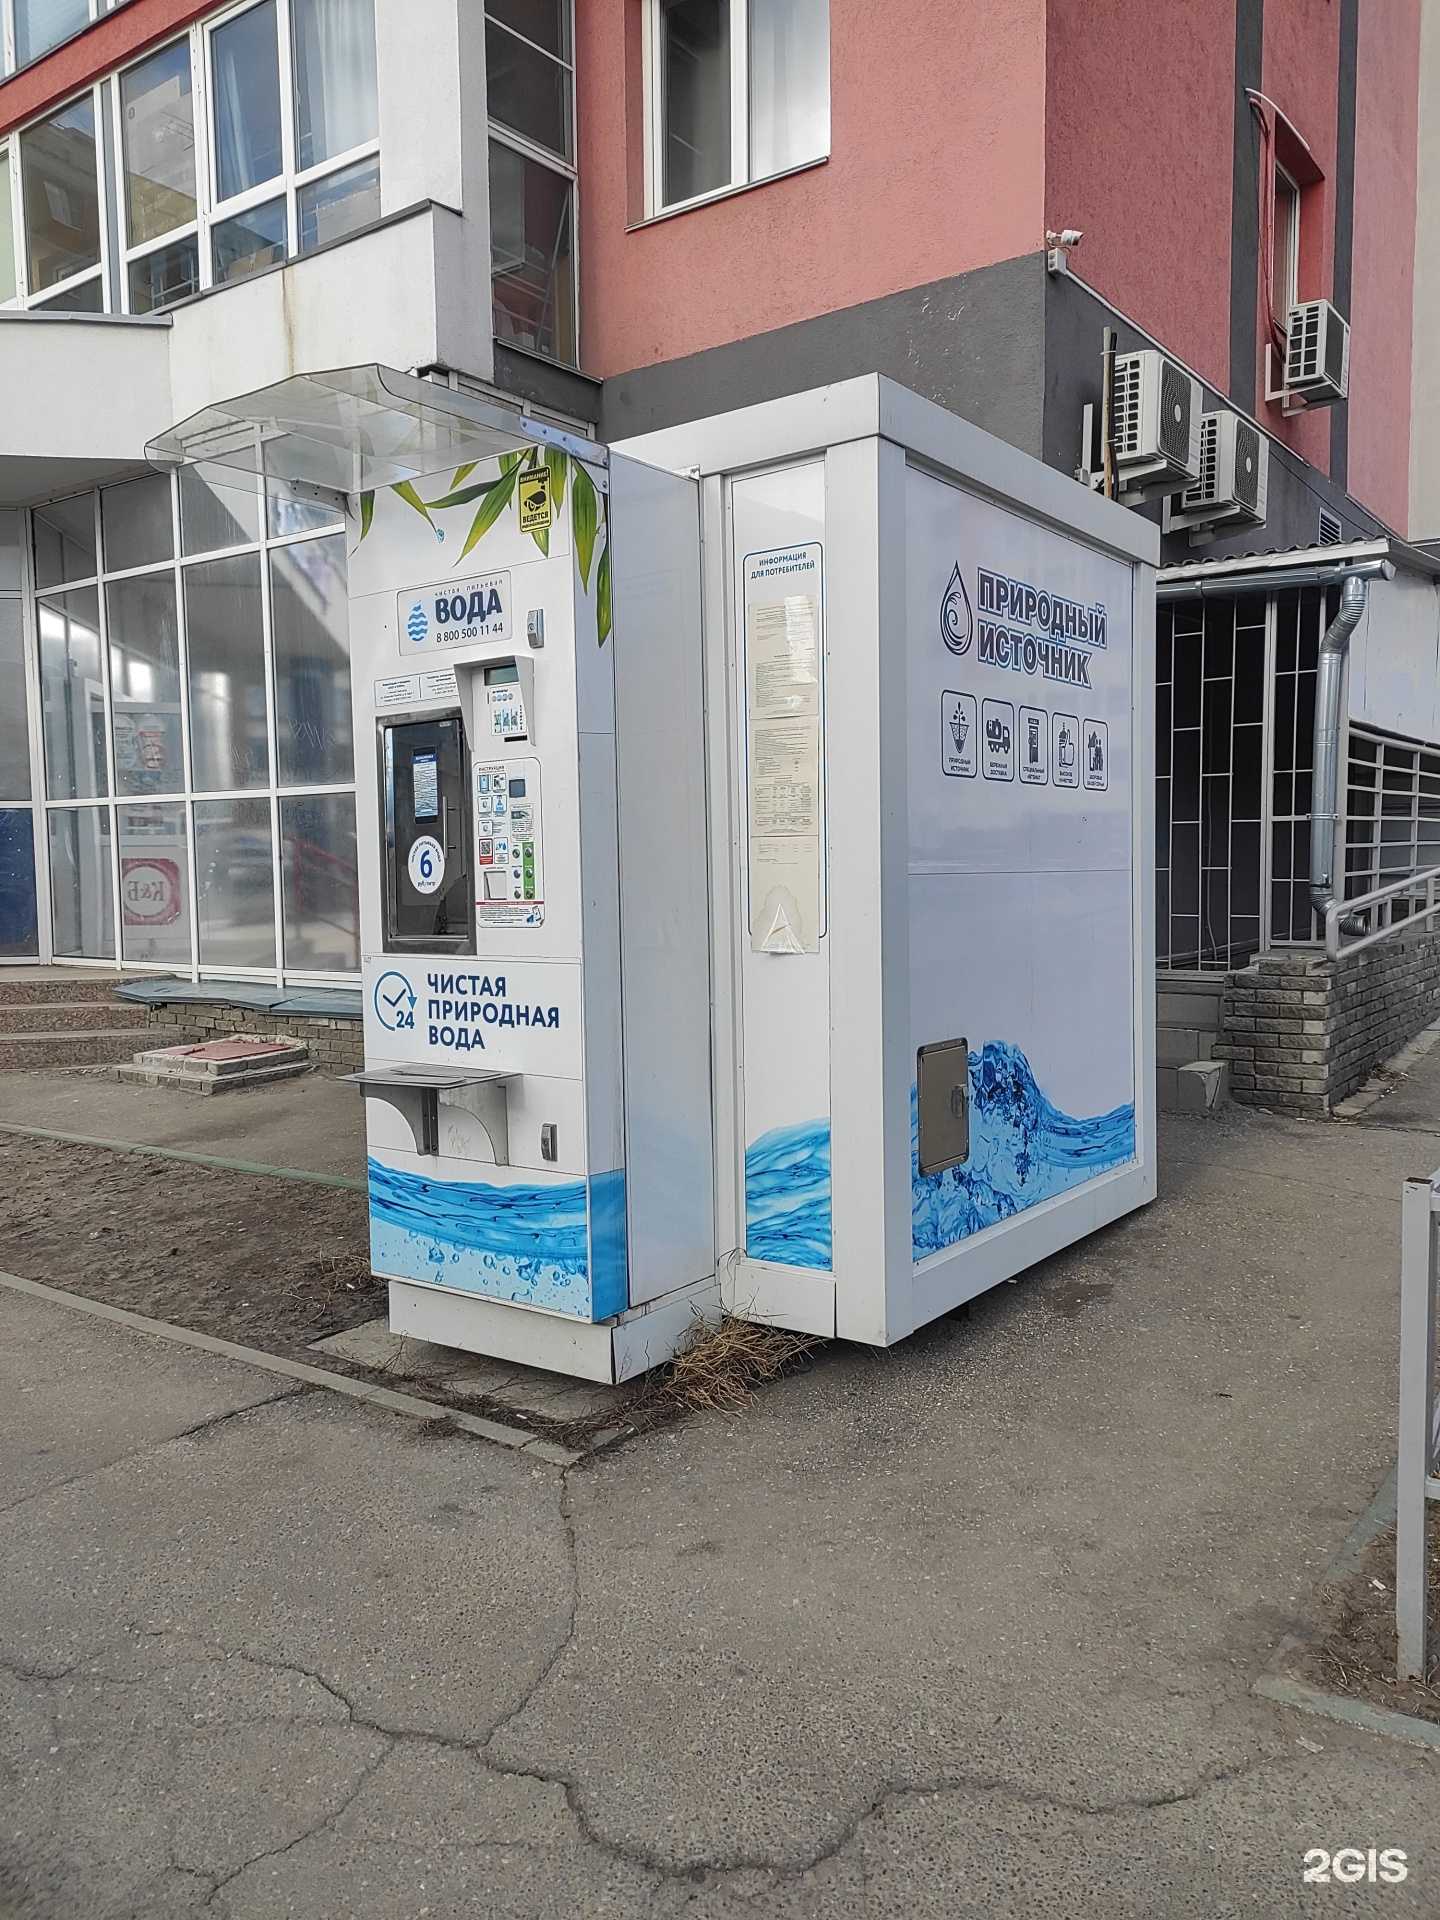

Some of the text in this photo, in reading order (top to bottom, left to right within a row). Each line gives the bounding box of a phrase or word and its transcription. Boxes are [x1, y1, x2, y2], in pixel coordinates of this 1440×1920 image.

[751, 560, 815, 579] ДЛЯ ПОТРЕБИТЕЛЕЙ
[759, 551, 807, 566] ИНФОРМАЦИЯ
[435, 588, 503, 625] ВОДА
[978, 567, 1107, 649] ПРИРОДНЫЙ
[436, 622, 503, 643] 8 800 500 11 44
[978, 619, 1092, 689] ИСТОЧНИК
[420, 850, 432, 878] 6
[427, 973, 506, 997] ЧИСТАЯ
[396, 1011, 415, 1029] 24
[428, 999, 560, 1028] ПРИРОДНАЯ
[429, 1025, 486, 1051] ВОДА
